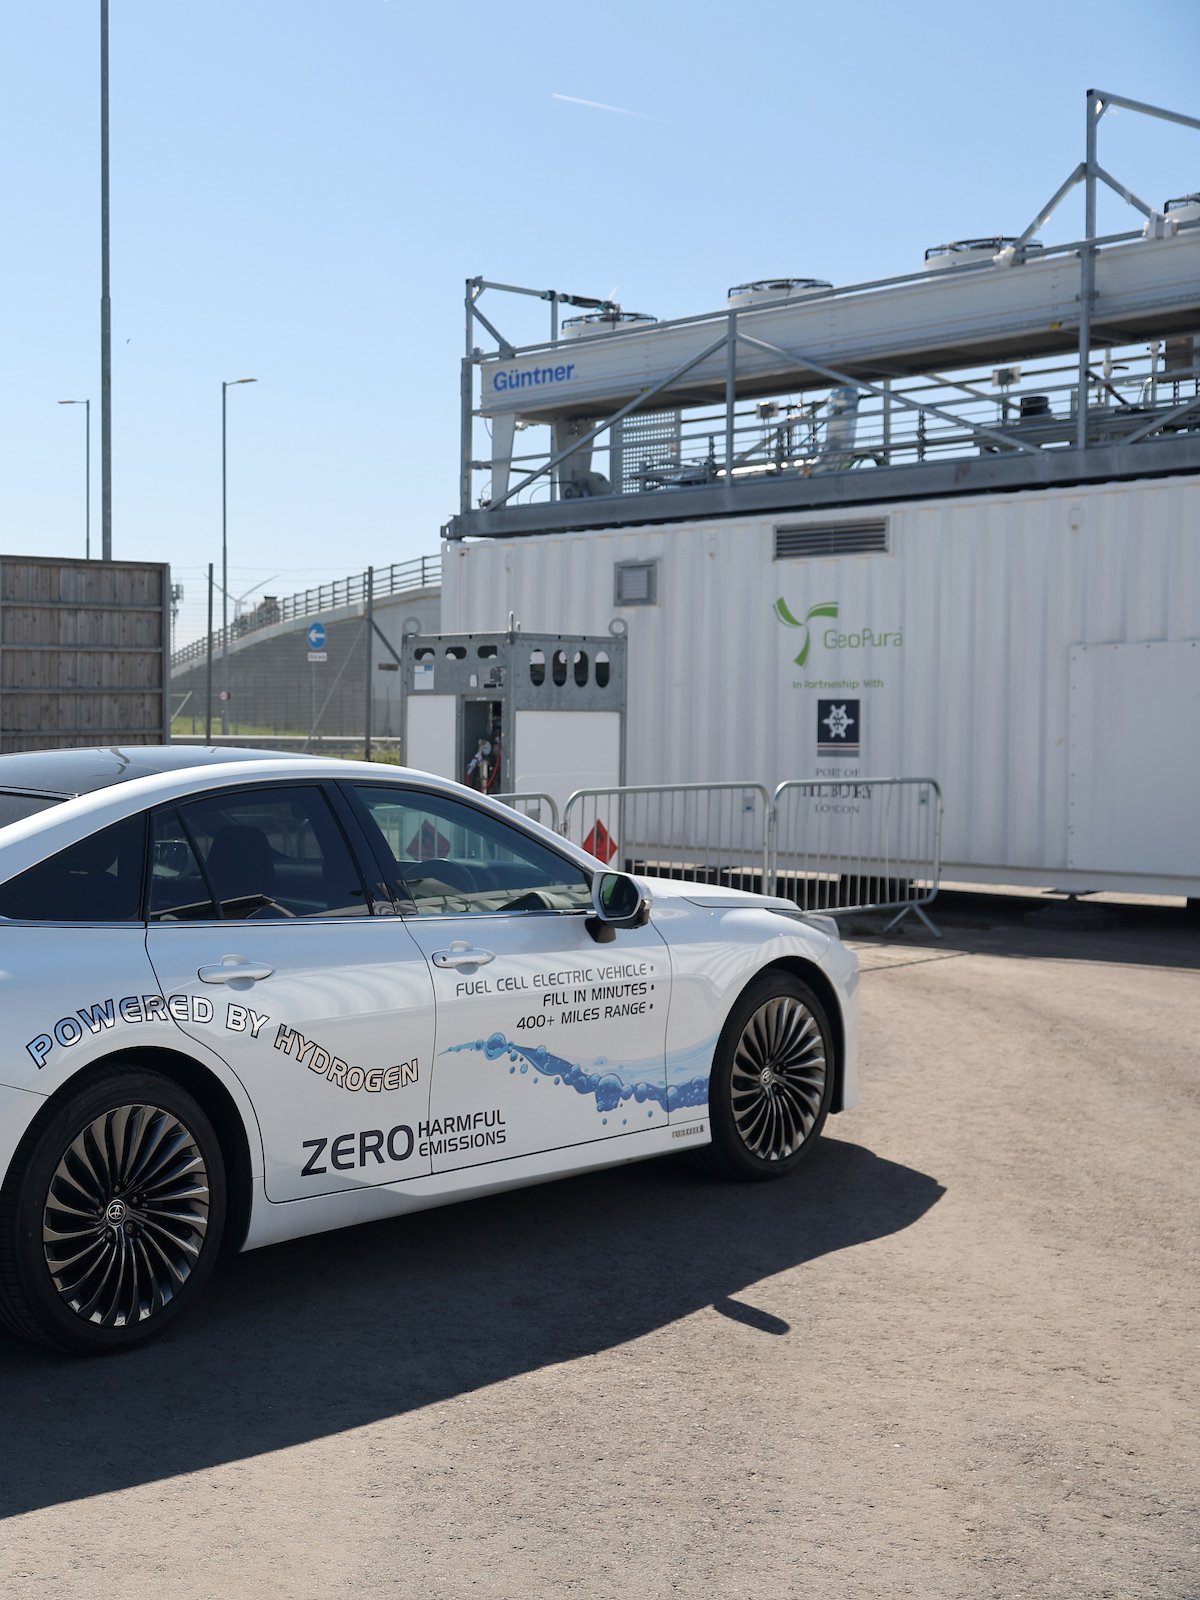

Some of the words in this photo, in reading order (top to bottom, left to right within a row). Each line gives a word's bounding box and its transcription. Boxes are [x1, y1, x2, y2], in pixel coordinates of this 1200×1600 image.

[492, 363, 575, 392] Güntner
[823, 627, 904, 649] GeoPura
[792, 680, 802, 689] In
[863, 679, 884, 689] With
[456, 981, 492, 996] FUEL
[497, 976, 530, 991] CELL
[533, 968, 593, 987] ELECTRIC
[597, 963, 647, 980] VEHICLE
[543, 993, 569, 1007] FILL
[574, 989, 587, 1003] IN
[591, 982, 647, 1001] MINUTES
[516, 1014, 555, 1030] 400+
[561, 1007, 600, 1025] MILES
[604, 1001, 646, 1019] RANGE
[26, 995, 214, 1069] POWERED
[226, 1003, 270, 1038] BY
[273, 1024, 419, 1092] HYDROGEN
[301, 1124, 415, 1177] ZERO
[418, 1109, 506, 1138] HARMFUL
[419, 1129, 506, 1157] EMISSIONS
